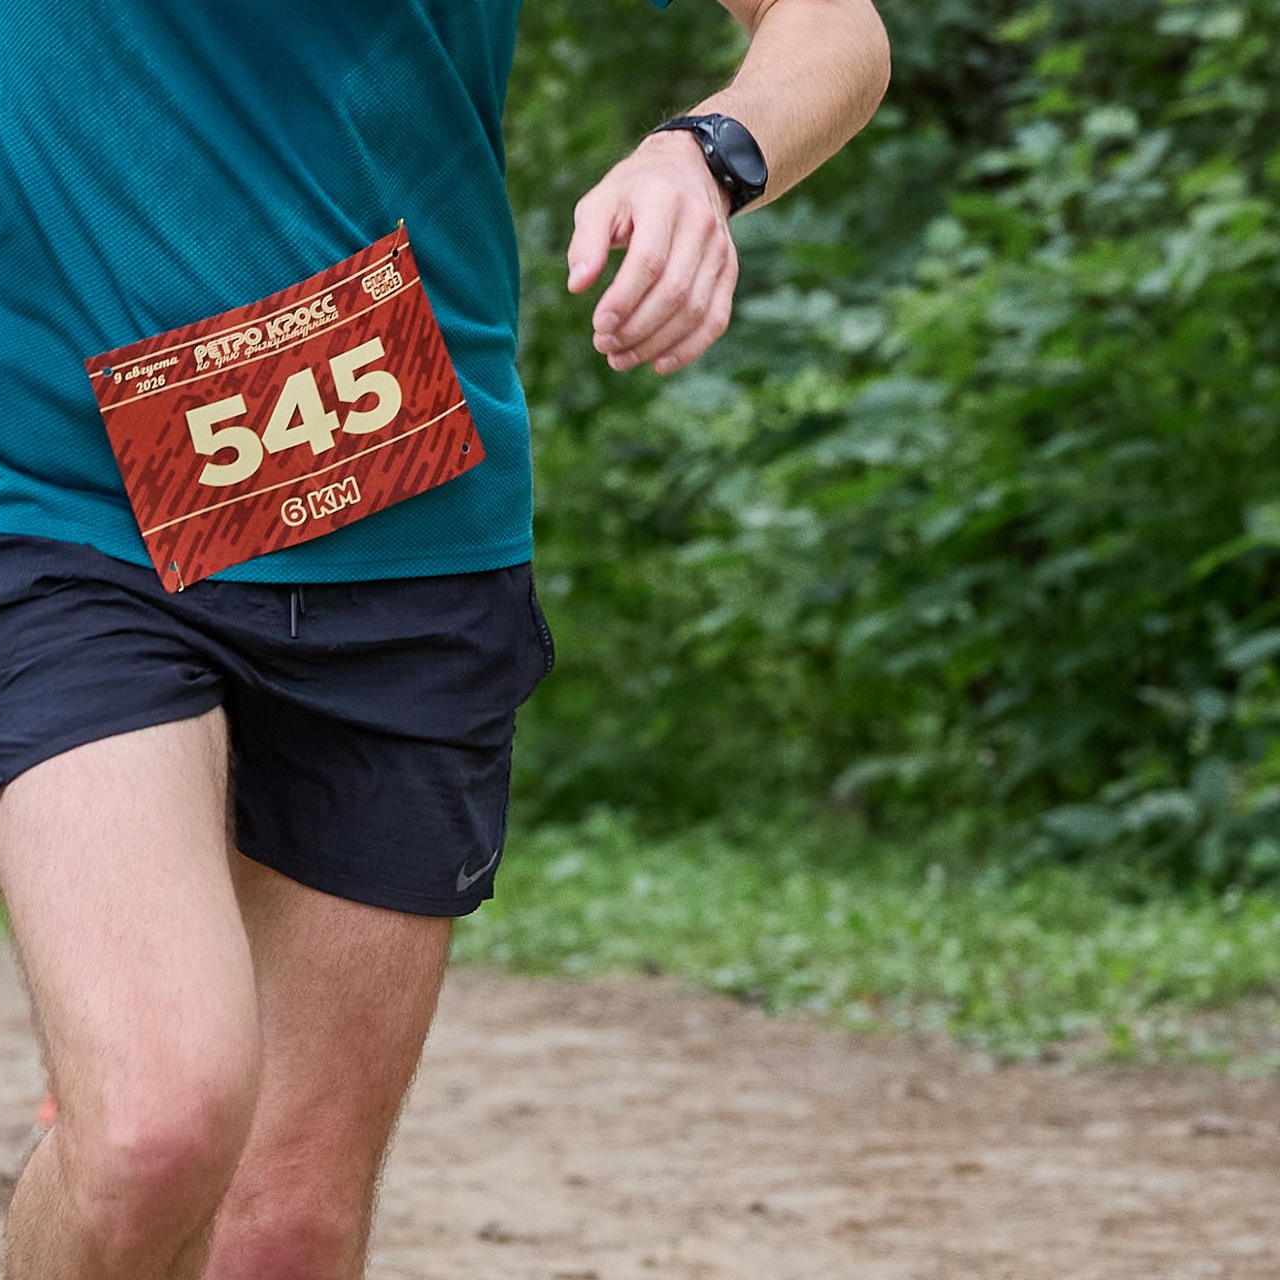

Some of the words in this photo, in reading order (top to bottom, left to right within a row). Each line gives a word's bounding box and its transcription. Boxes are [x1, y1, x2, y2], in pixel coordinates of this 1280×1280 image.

[193, 327, 263, 364] РЕТРО
[265, 293, 337, 340] КРОСС
[244, 310, 340, 359] физкультурника
[113, 371, 123, 385] 9
[124, 355, 180, 381] августа
[135, 373, 167, 395] 2026
[185, 337, 403, 488] 545
[280, 498, 308, 527] 6
